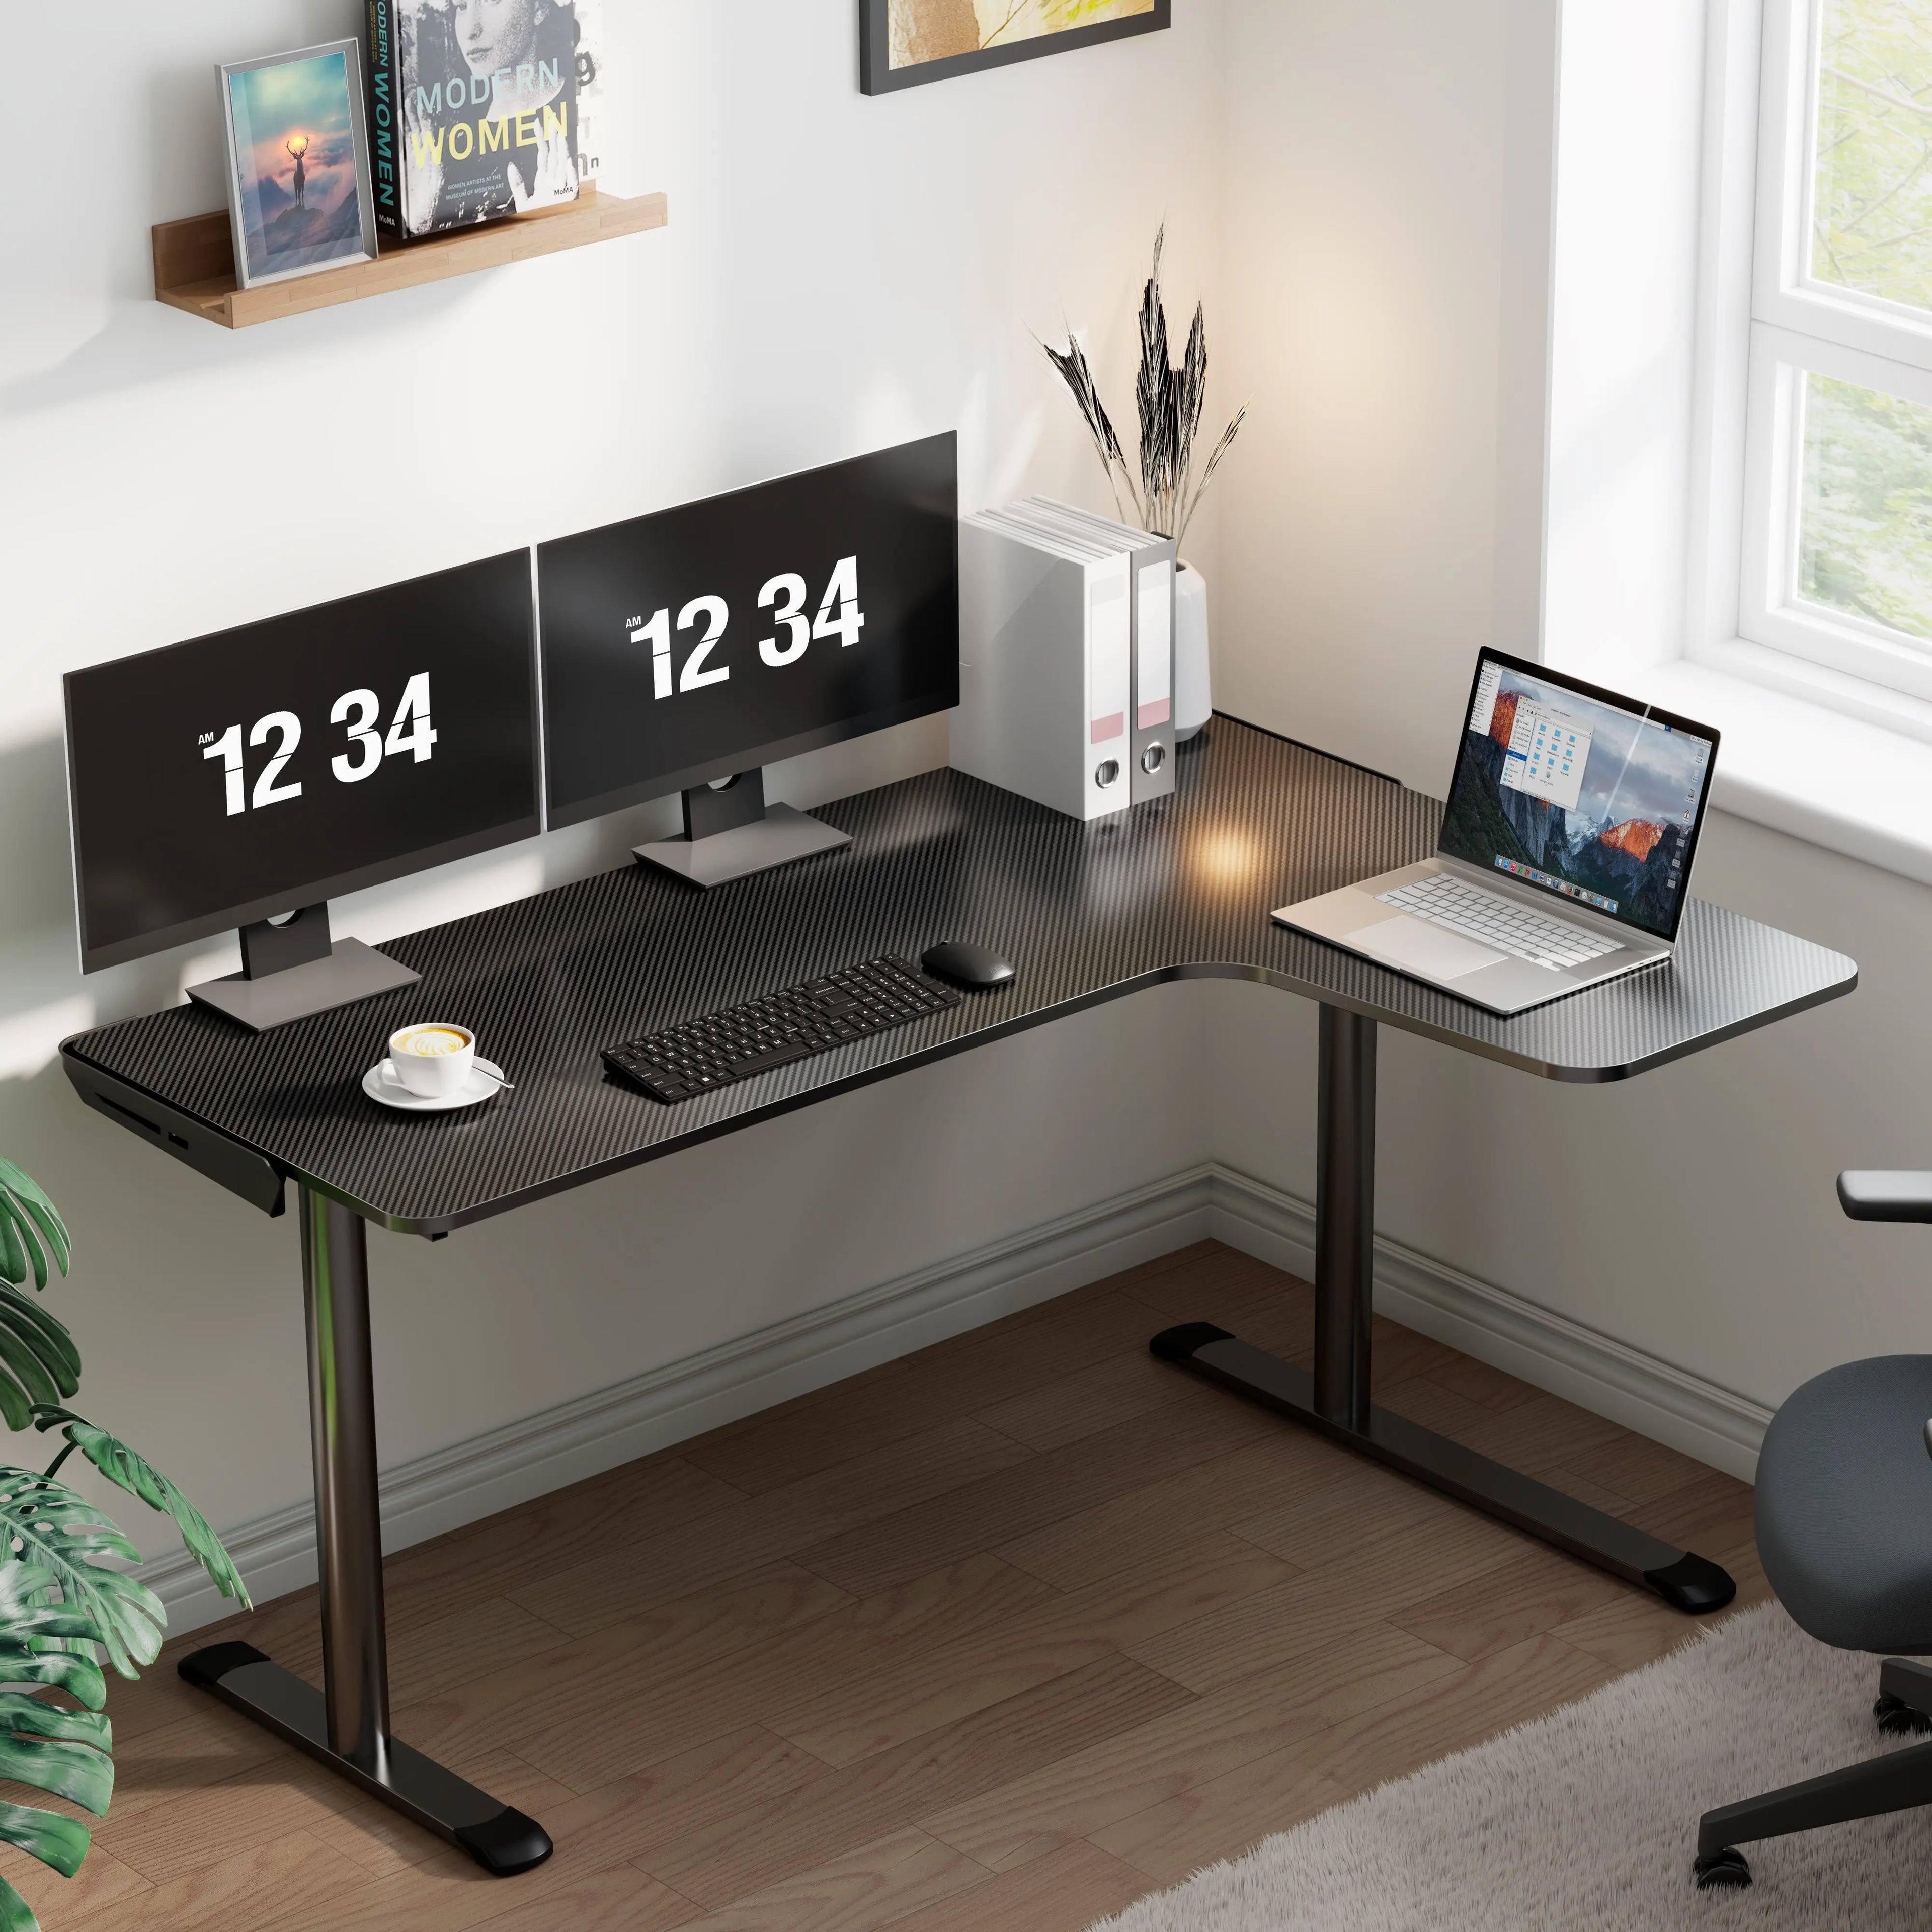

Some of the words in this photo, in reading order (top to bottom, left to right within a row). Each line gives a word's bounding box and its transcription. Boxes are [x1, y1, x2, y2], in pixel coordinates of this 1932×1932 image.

[378, 0, 388, 67] ODERN
[417, 58, 558, 116] MODERN
[375, 73, 394, 206] WOMEN
[411, 101, 567, 169] WOMEN
[446, 190, 467, 200] MUSEUM
[474, 185, 495, 193] MODERN
[447, 182, 466, 190] WOMEN
[466, 177, 486, 186] ARTISTS
[554, 187, 574, 196] MoMA
[379, 215, 395, 226] MoMA
[625, 615, 641, 628] AM
[631, 595, 730, 700] 12
[758, 555, 865, 667] 34
[198, 732, 214, 745] AM
[203, 711, 302, 816] 12
[331, 671, 437, 783] 34
